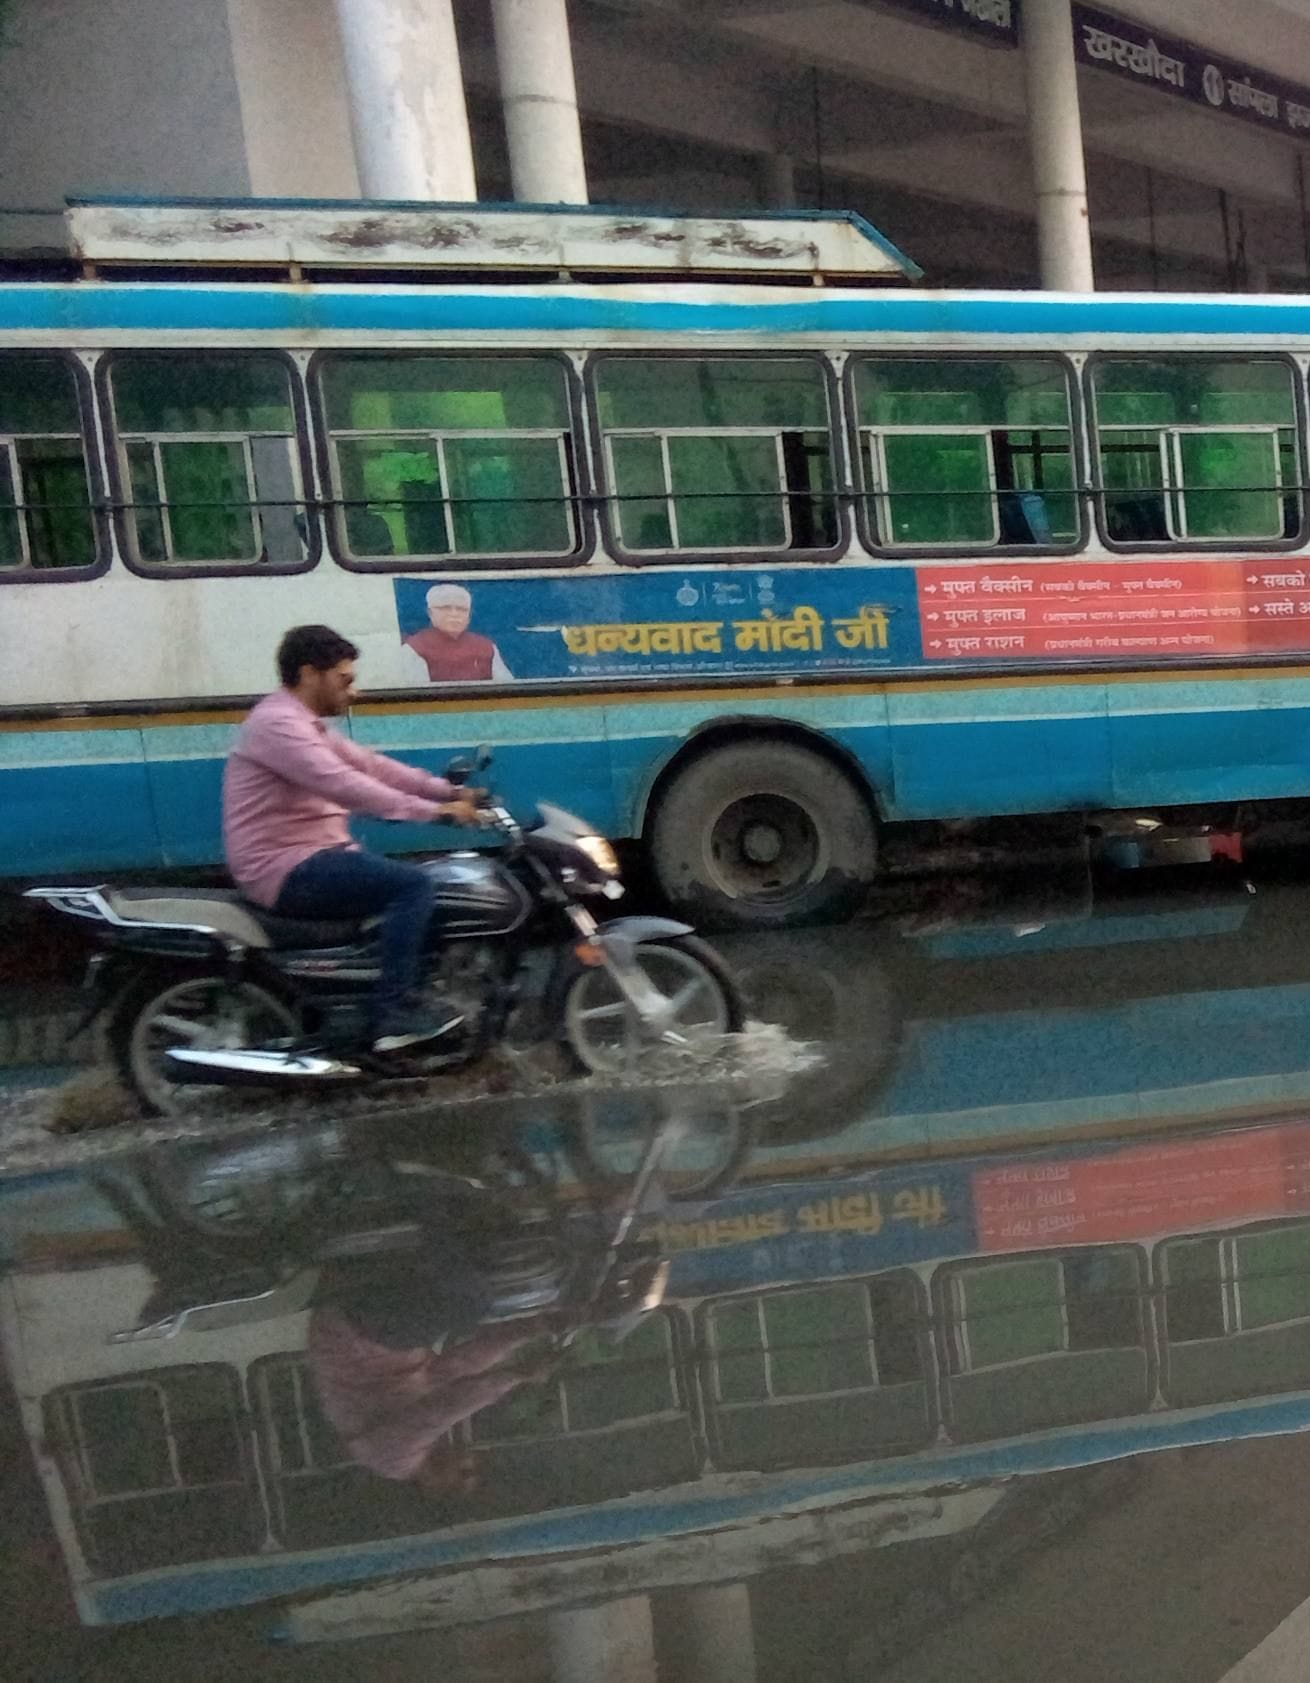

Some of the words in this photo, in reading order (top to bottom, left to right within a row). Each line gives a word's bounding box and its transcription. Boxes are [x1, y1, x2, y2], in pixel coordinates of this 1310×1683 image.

[980, 575, 1034, 593] वैक्सीन
[1261, 570, 1305, 587] सबको
[1264, 598, 1295, 616] सस्ते
[982, 608, 1026, 625] इलाज
[565, 622, 724, 657] धन्यवाद
[831, 606, 890, 650] जी
[985, 636, 1025, 650] राशन
